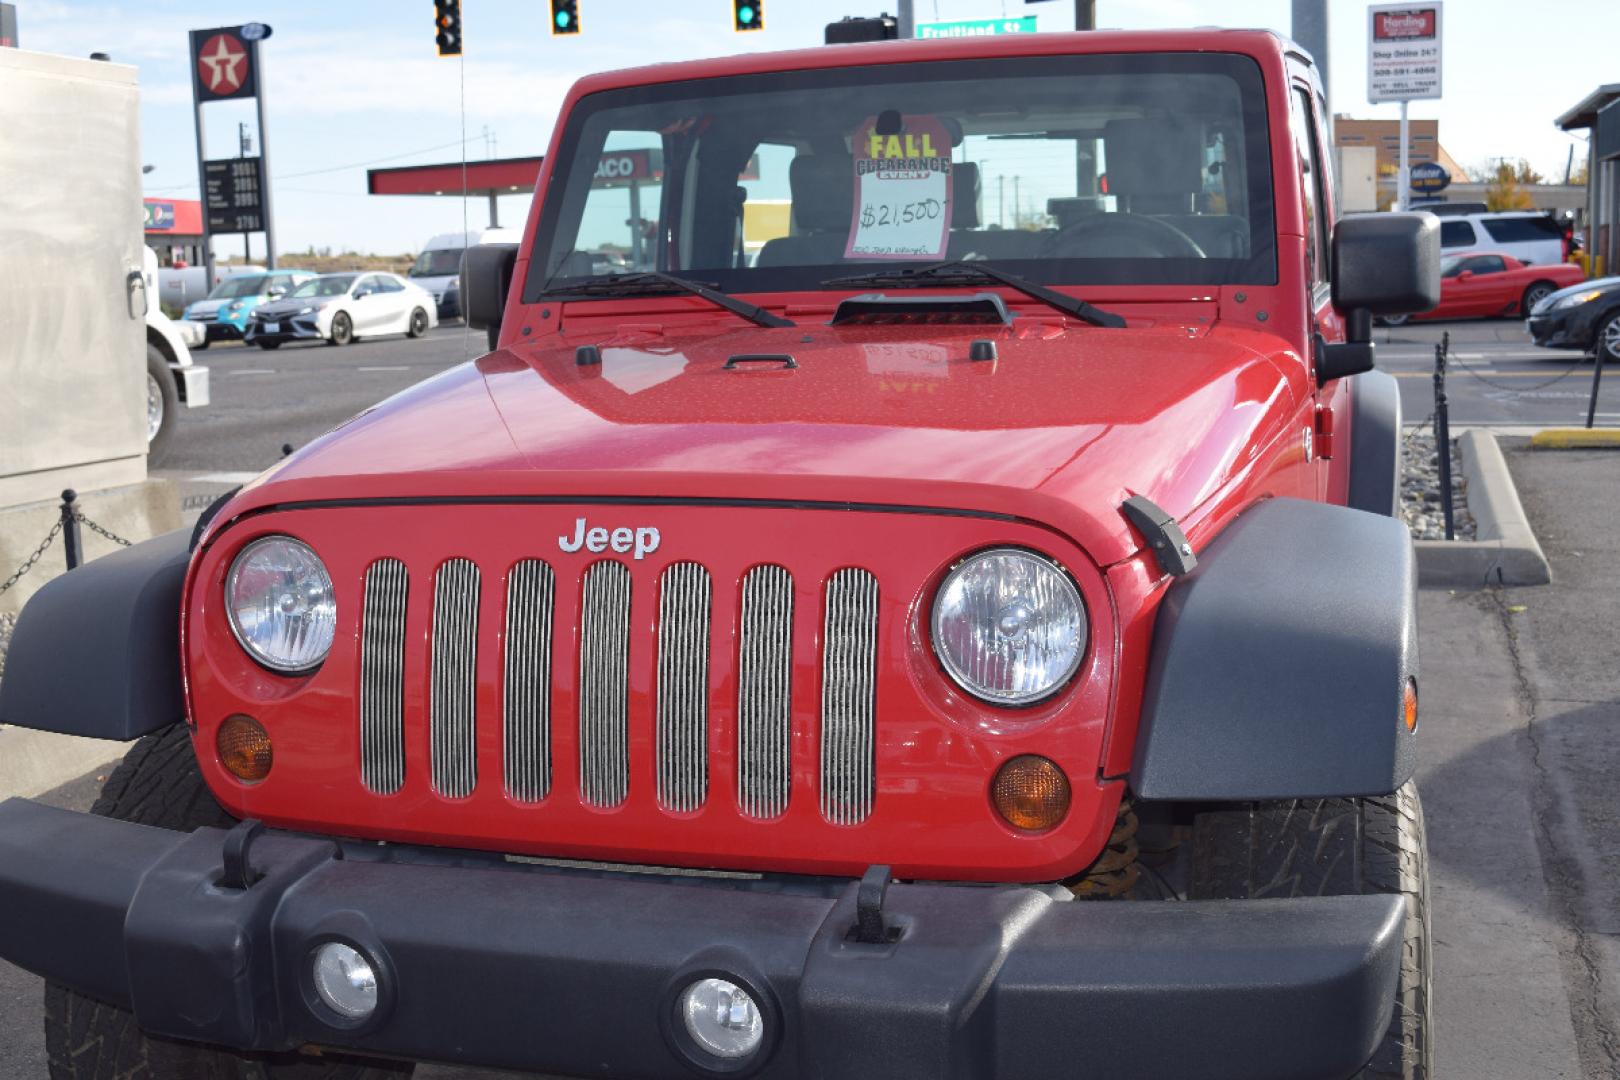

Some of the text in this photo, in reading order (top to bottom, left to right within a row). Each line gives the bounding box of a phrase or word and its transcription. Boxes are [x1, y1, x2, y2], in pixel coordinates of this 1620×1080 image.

[922, 22, 1020, 38] Fruitland St
[870, 134, 936, 159] FALL
[856, 157, 952, 177] CLEARANCE
[879, 170, 929, 179] EVENT
[558, 517, 661, 560] Jeep
